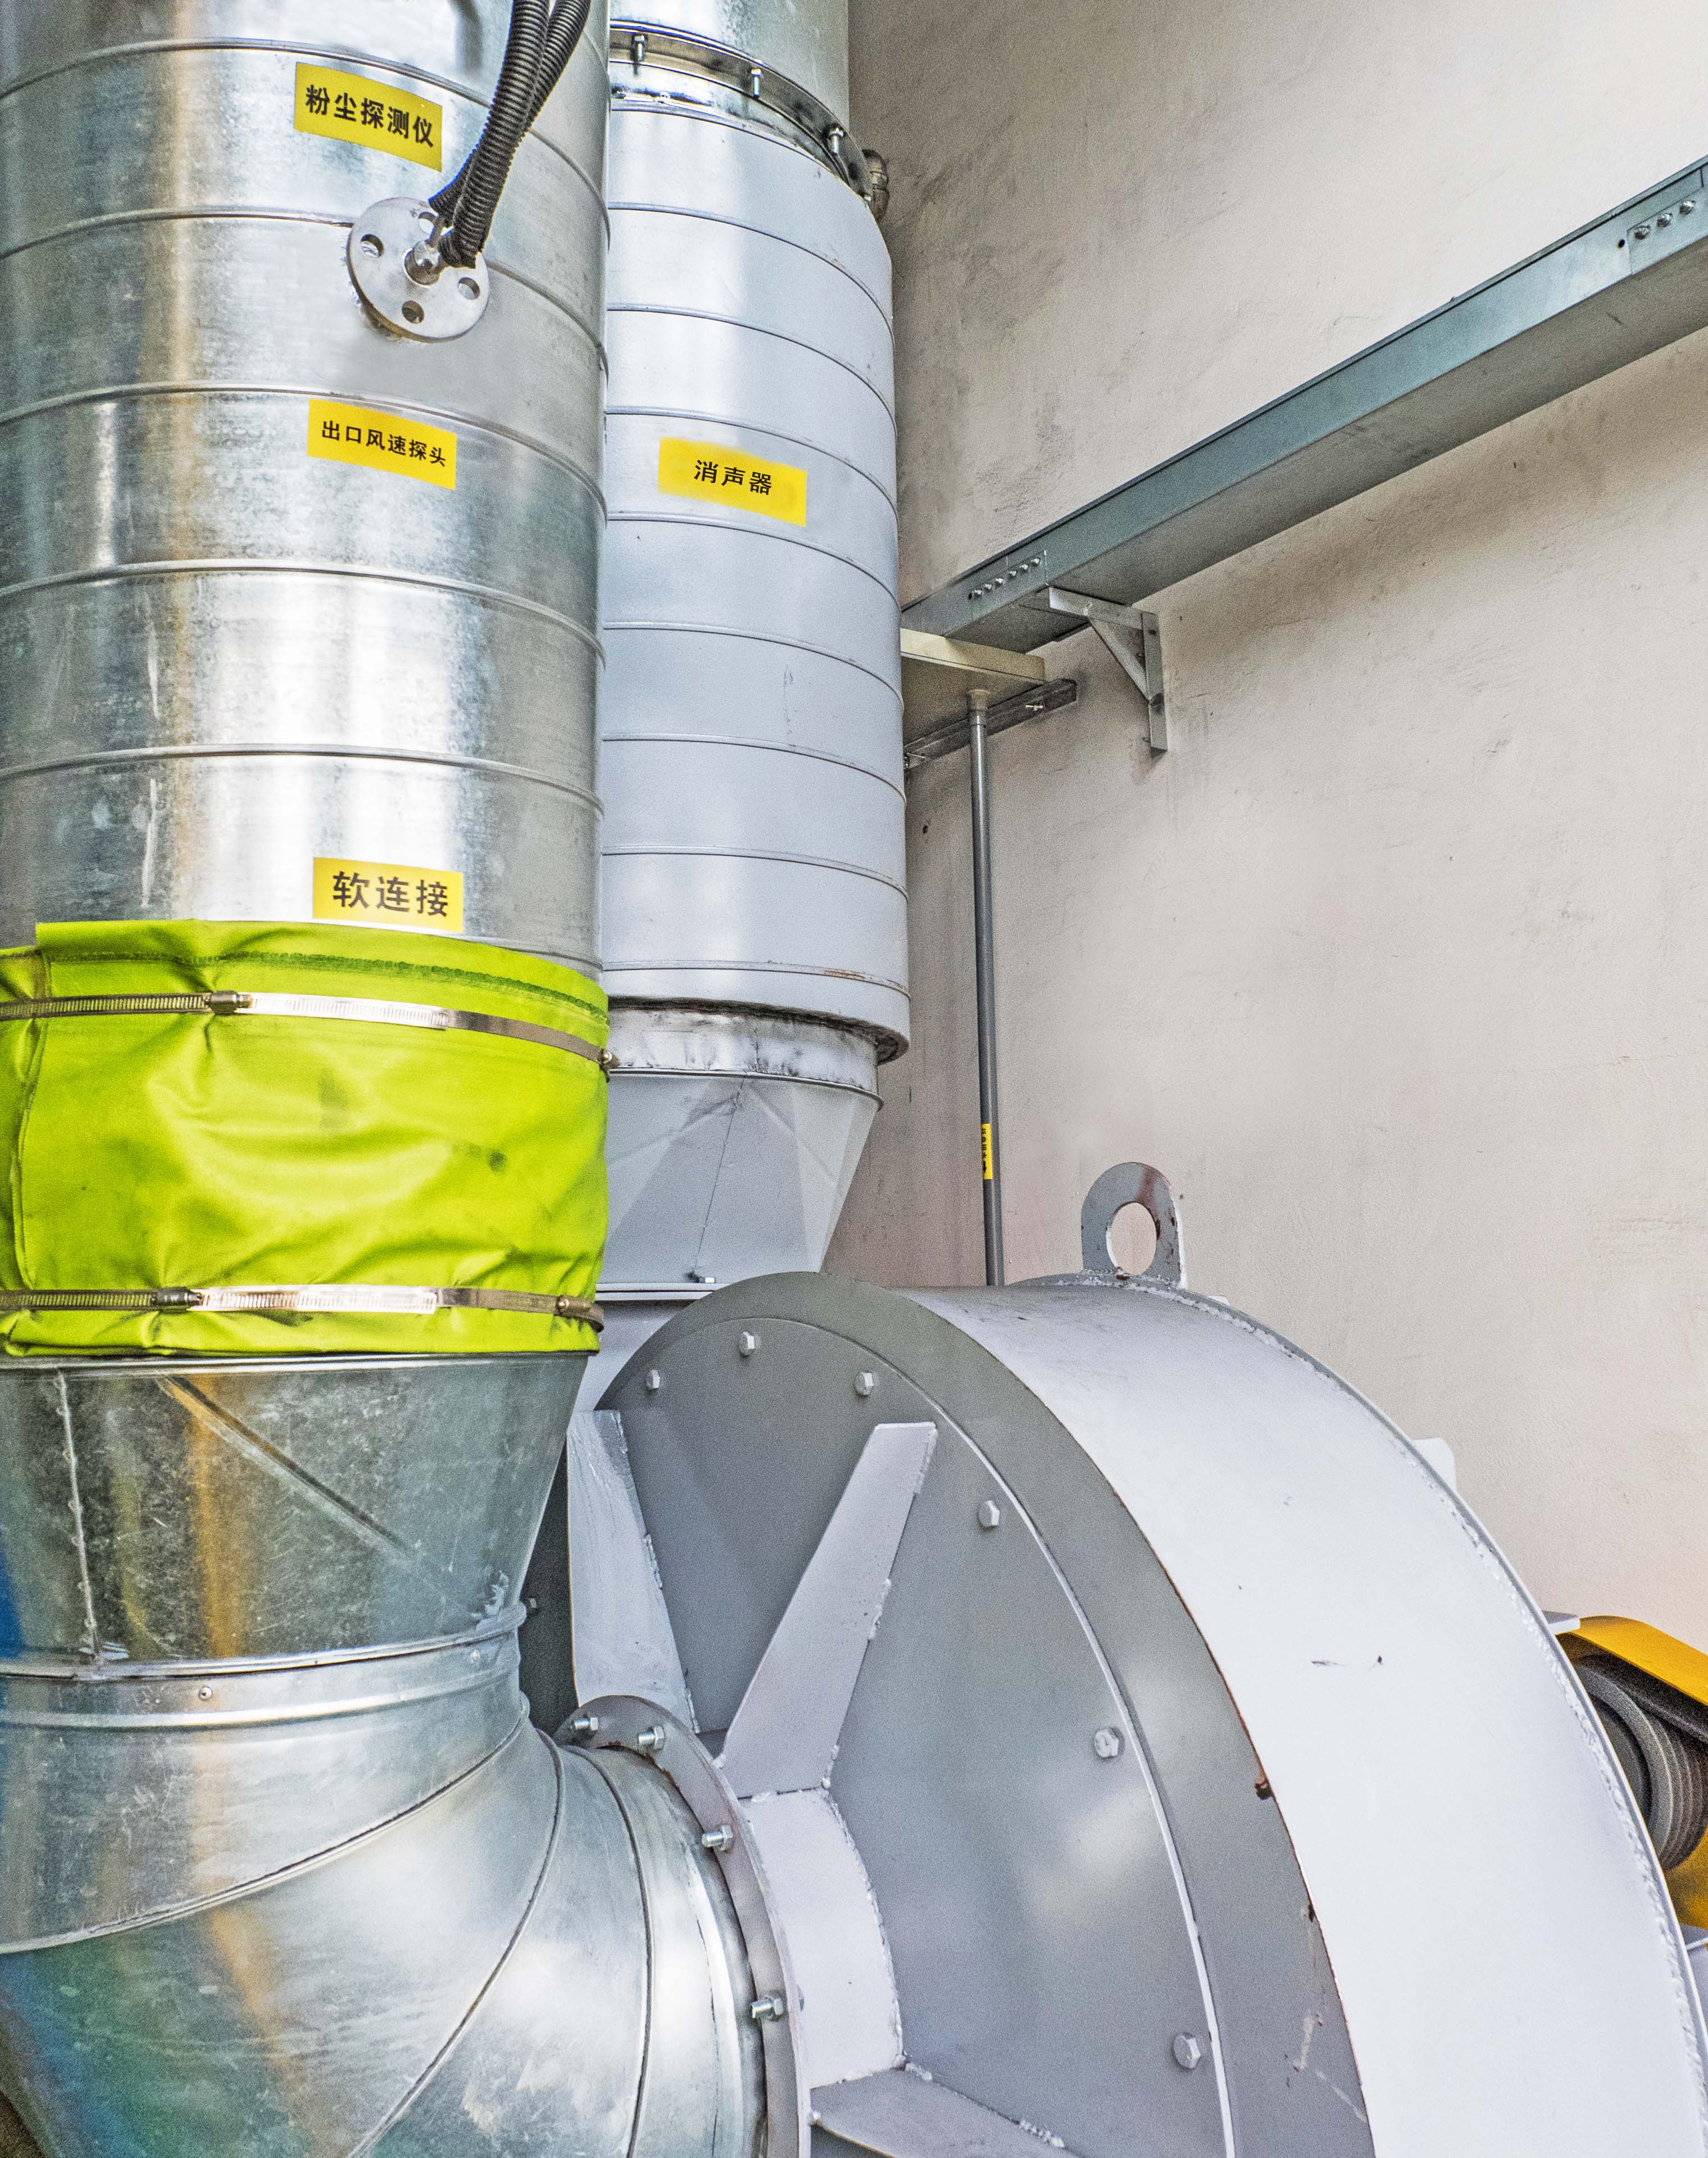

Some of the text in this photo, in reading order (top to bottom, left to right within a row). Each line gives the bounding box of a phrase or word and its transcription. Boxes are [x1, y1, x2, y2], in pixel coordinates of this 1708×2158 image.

[305, 84, 434, 147] 粉尘探测仪
[322, 420, 446, 467] 出口风速探头
[694, 460, 772, 495] 消声器
[333, 871, 448, 917] 软连接
